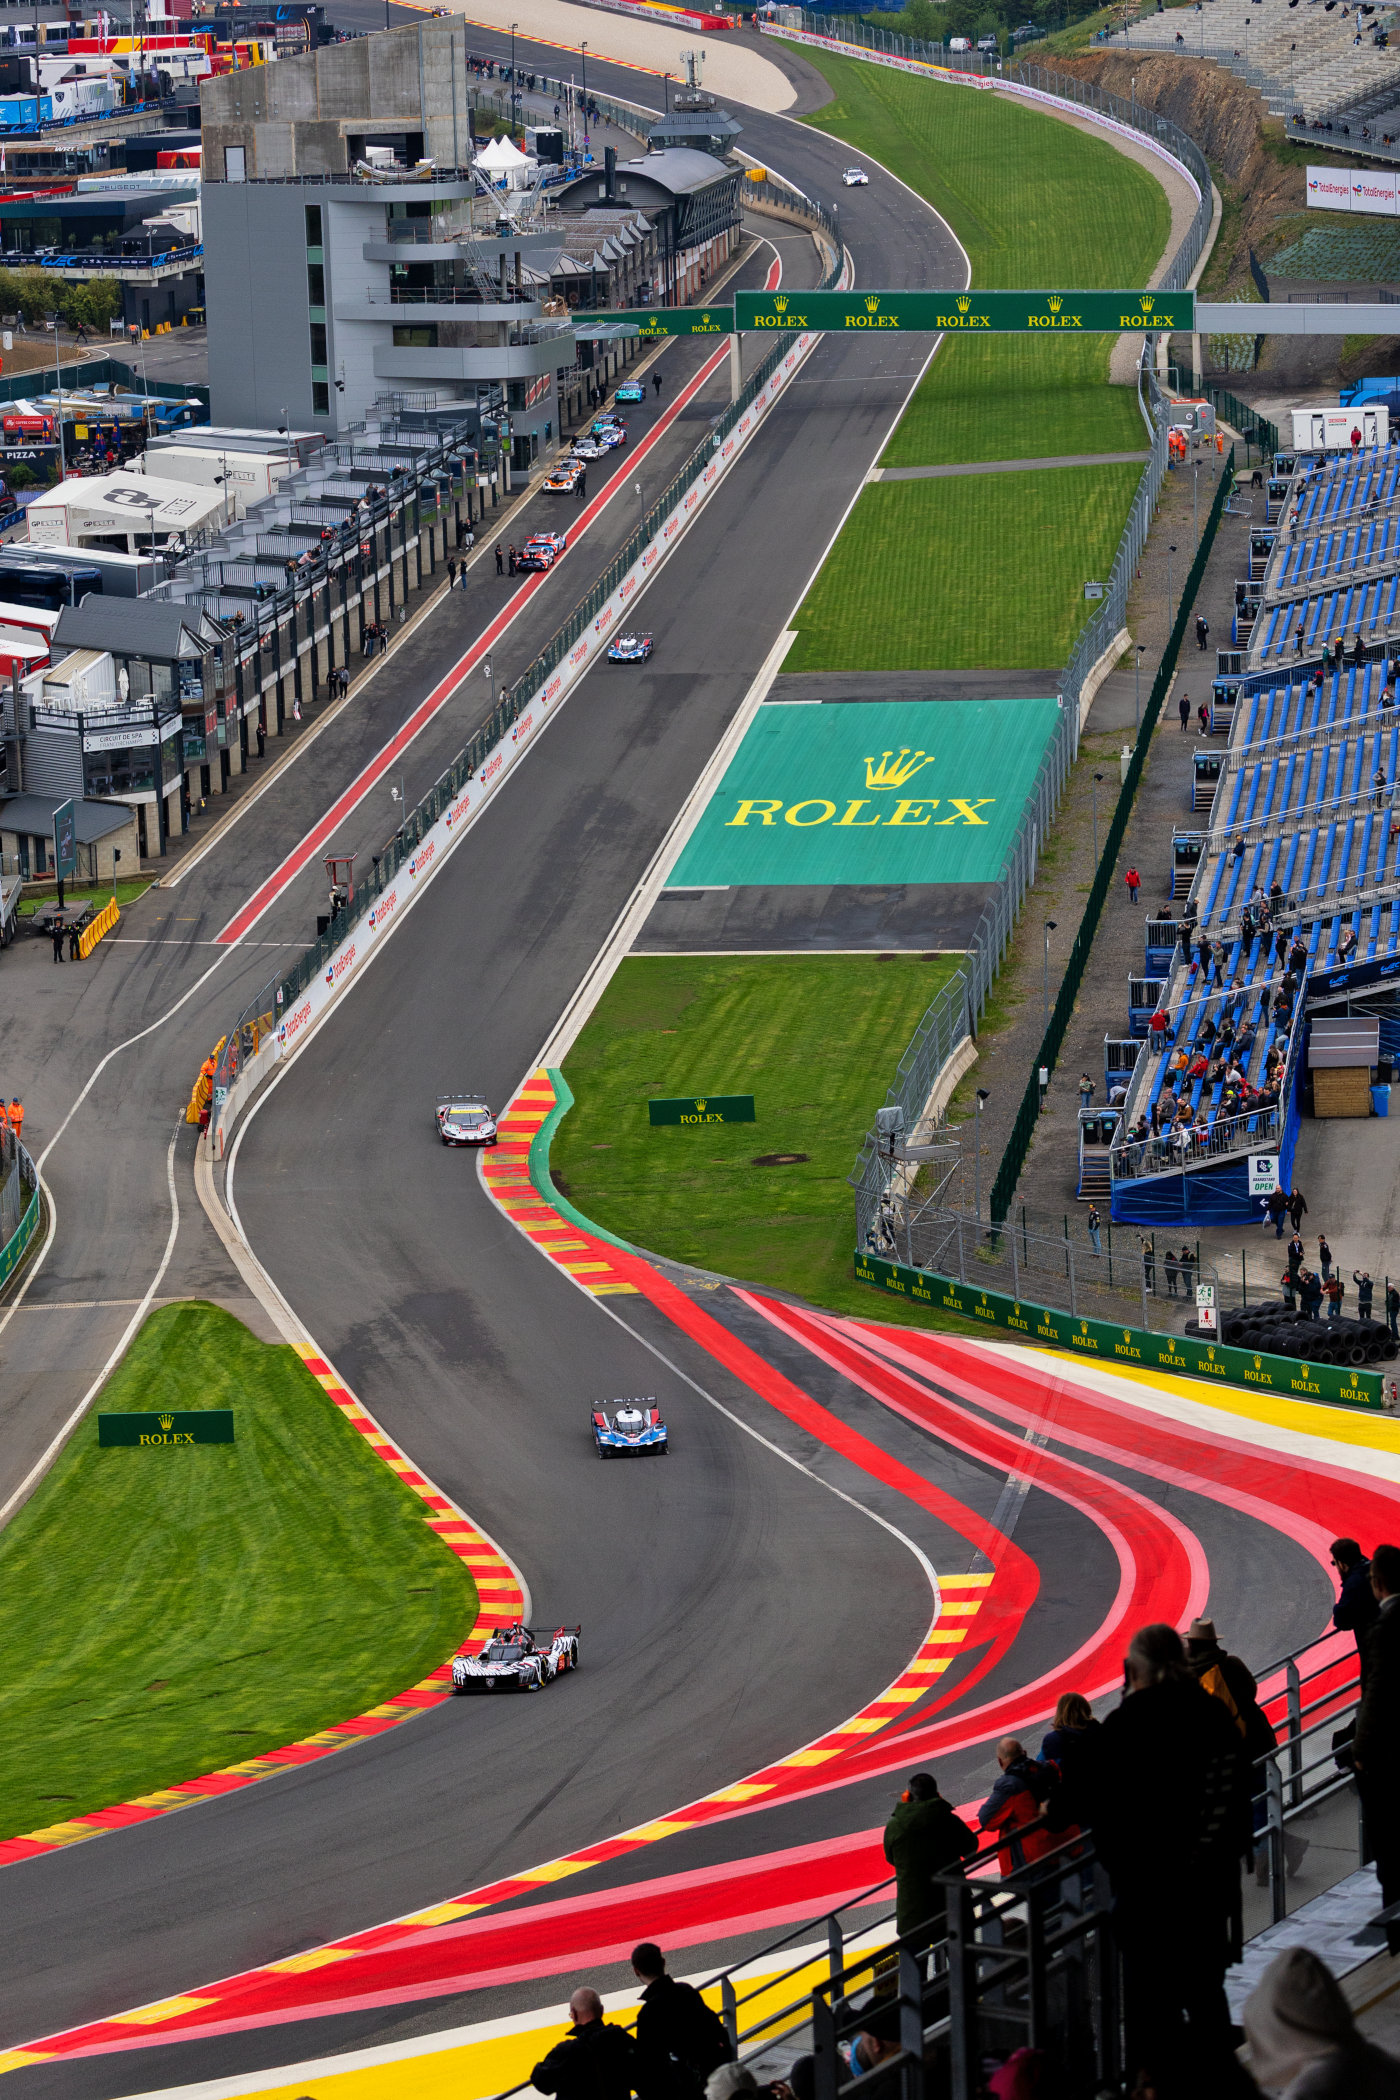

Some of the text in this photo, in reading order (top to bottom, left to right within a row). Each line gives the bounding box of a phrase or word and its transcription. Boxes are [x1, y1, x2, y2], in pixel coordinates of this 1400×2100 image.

[1318, 182, 1349, 197] TotalEnergies
[1362, 186, 1395, 201] TotalEnergies
[41, 256, 77, 267] WEC
[754, 315, 809, 327] ROLEX
[845, 315, 900, 327] ROLEX
[937, 315, 992, 327] ROLEX
[1028, 315, 1083, 327] ROLEX
[1120, 315, 1175, 327] ROLEX
[638, 327, 669, 336] ROLEX
[691, 324, 721, 333] ROLEX
[6, 451, 36, 459] PIZZA
[99, 735, 121, 743] CIRCUIT
[99, 738, 143, 748] FRANCORCHAMPS
[451, 795, 471, 824] TotalEnergies
[725, 798, 996, 827] ROLEX
[415, 841, 435, 872] TotalEnergies
[375, 890, 397, 923] TotalEnergies
[332, 944, 356, 979] TotalEnergies
[285, 1001, 312, 1039] TotalEnergies
[680, 1113, 725, 1124] ROLEX
[1254, 1182, 1274, 1191] OPEN
[856, 1267, 875, 1282] ROLEX
[886, 1278, 905, 1292] ROLEX
[912, 1286, 931, 1300] ROLEX
[943, 1296, 963, 1310] ROLEX
[975, 1305, 995, 1320] ROLEX
[1008, 1316, 1028, 1331] ROLEX
[1037, 1325, 1058, 1339] ROLEX
[1072, 1335, 1098, 1349] ROLEX
[1115, 1344, 1141, 1358] ROLEX
[1159, 1353, 1186, 1367] ROLEX
[1198, 1361, 1226, 1375] ROLEX
[1244, 1370, 1272, 1384] ROLEX
[1291, 1379, 1320, 1394] ROLEX
[1340, 1388, 1370, 1402] ROLEX
[139, 1433, 195, 1446] ROLEX
